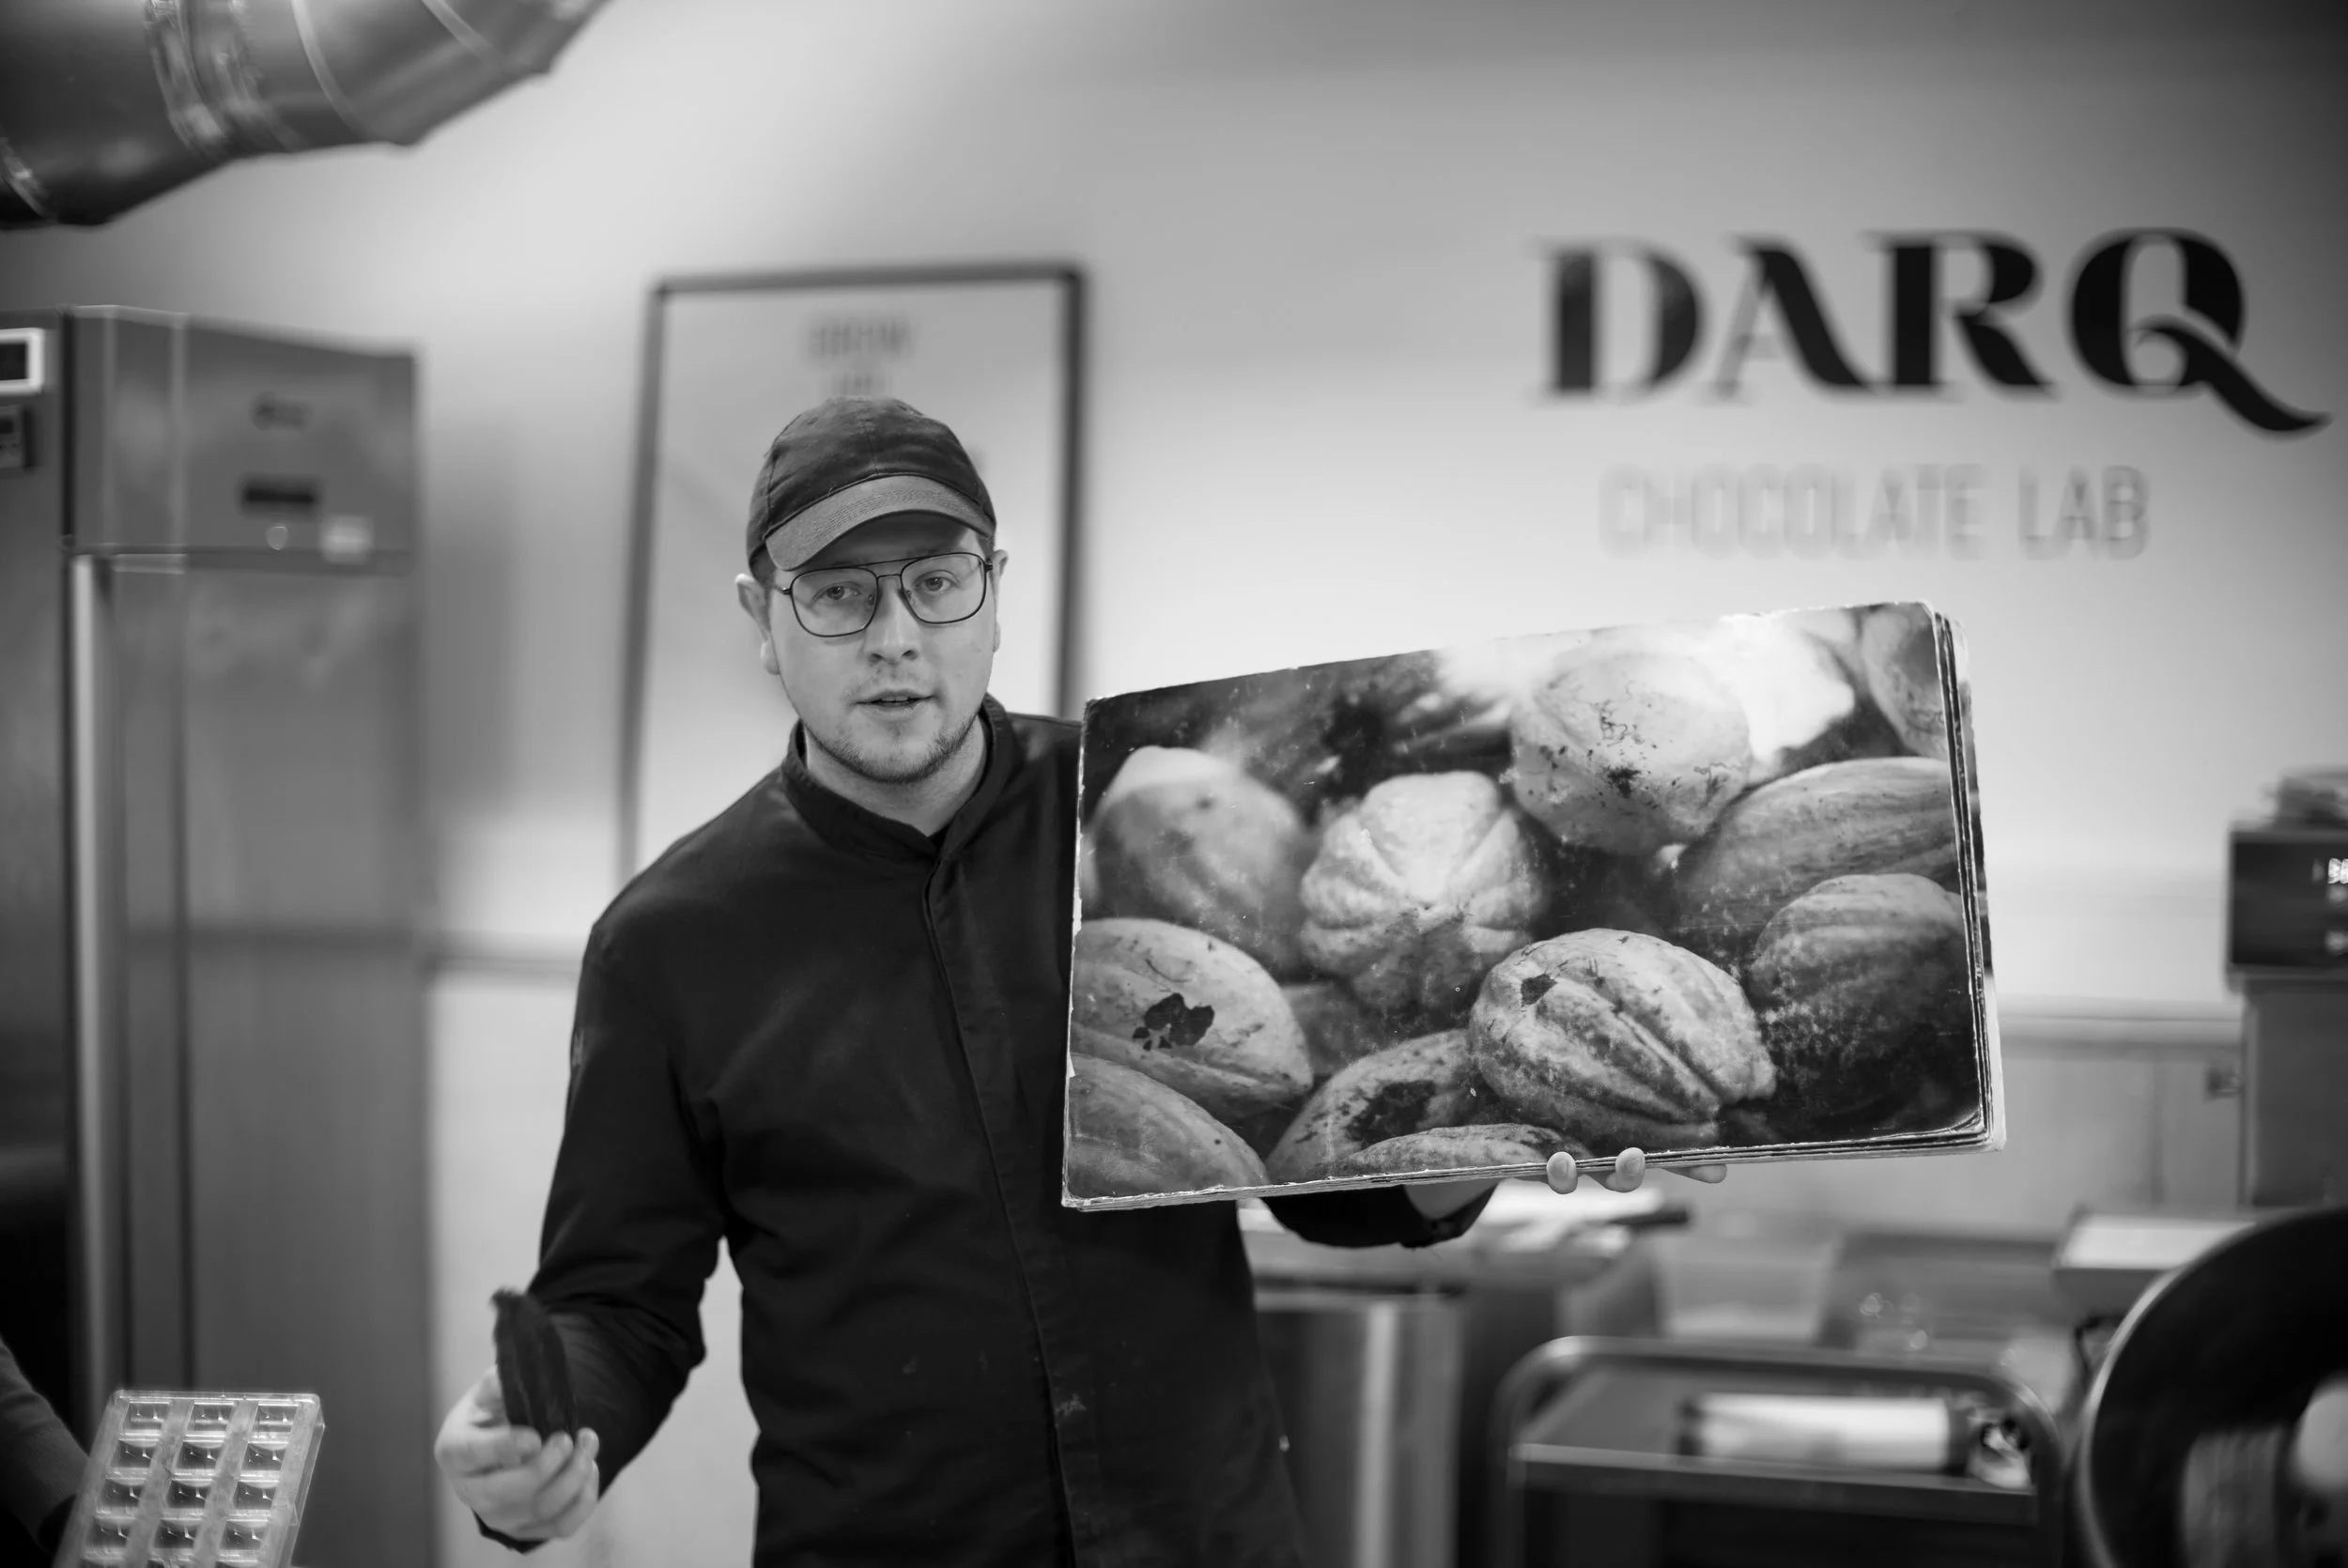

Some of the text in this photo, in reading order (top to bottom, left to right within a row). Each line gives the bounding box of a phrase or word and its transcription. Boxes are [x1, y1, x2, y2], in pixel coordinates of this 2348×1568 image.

[1529, 228, 2332, 439] DARQ
[1599, 463, 2151, 560] CHOCOLATE LAB
